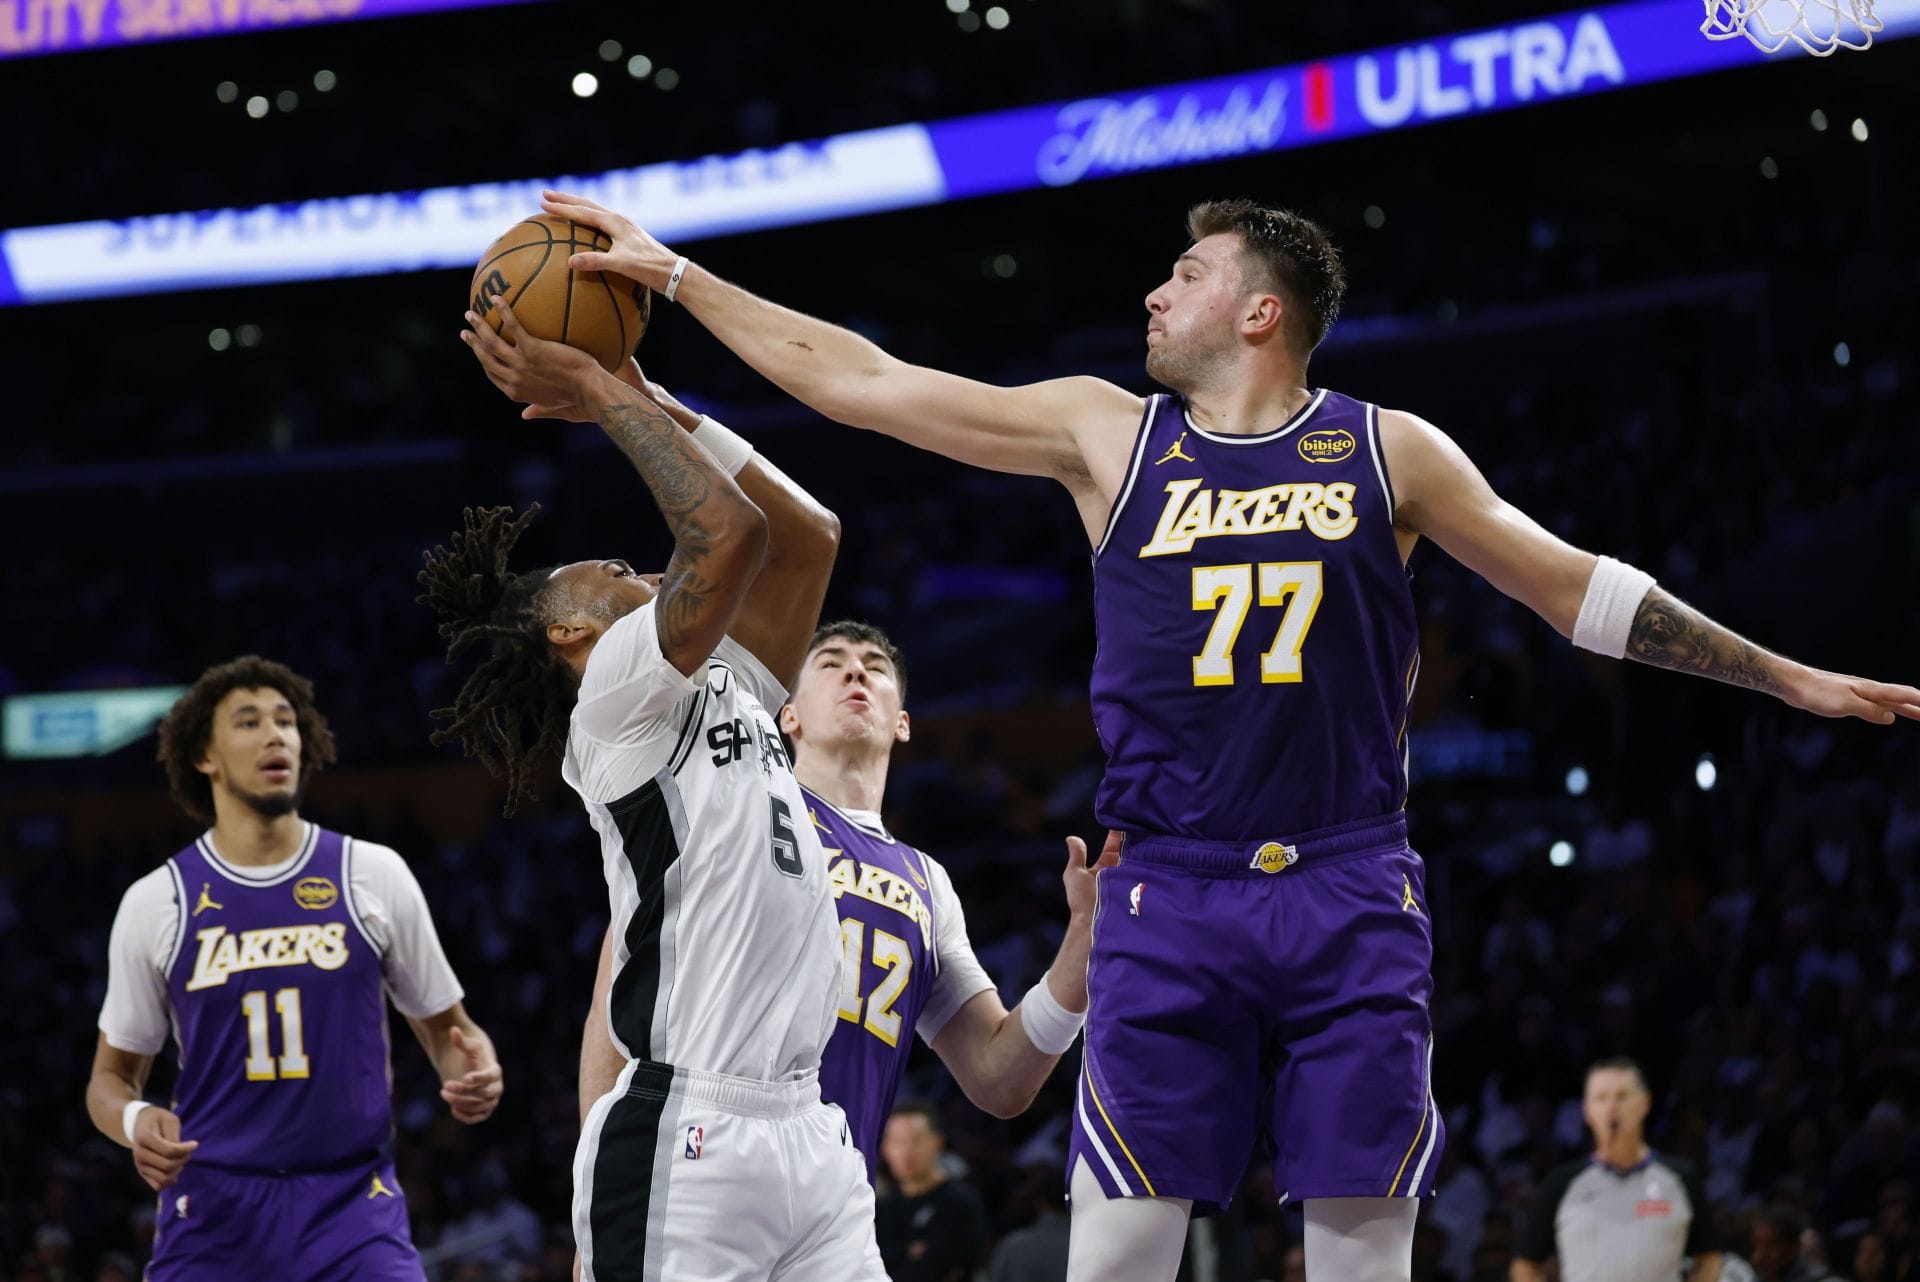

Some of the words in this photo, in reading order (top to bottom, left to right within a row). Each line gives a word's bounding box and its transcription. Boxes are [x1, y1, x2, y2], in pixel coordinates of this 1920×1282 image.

[1357, 14, 1625, 127] ULTRA
[1303, 438, 1352, 453] bibigo
[1139, 478, 1359, 558] LAKERS
[1192, 561, 1323, 687] 77
[768, 794, 805, 879] 5
[186, 922, 349, 992] LAKERS
[838, 916, 913, 1048] 12
[242, 987, 310, 1081] 11
